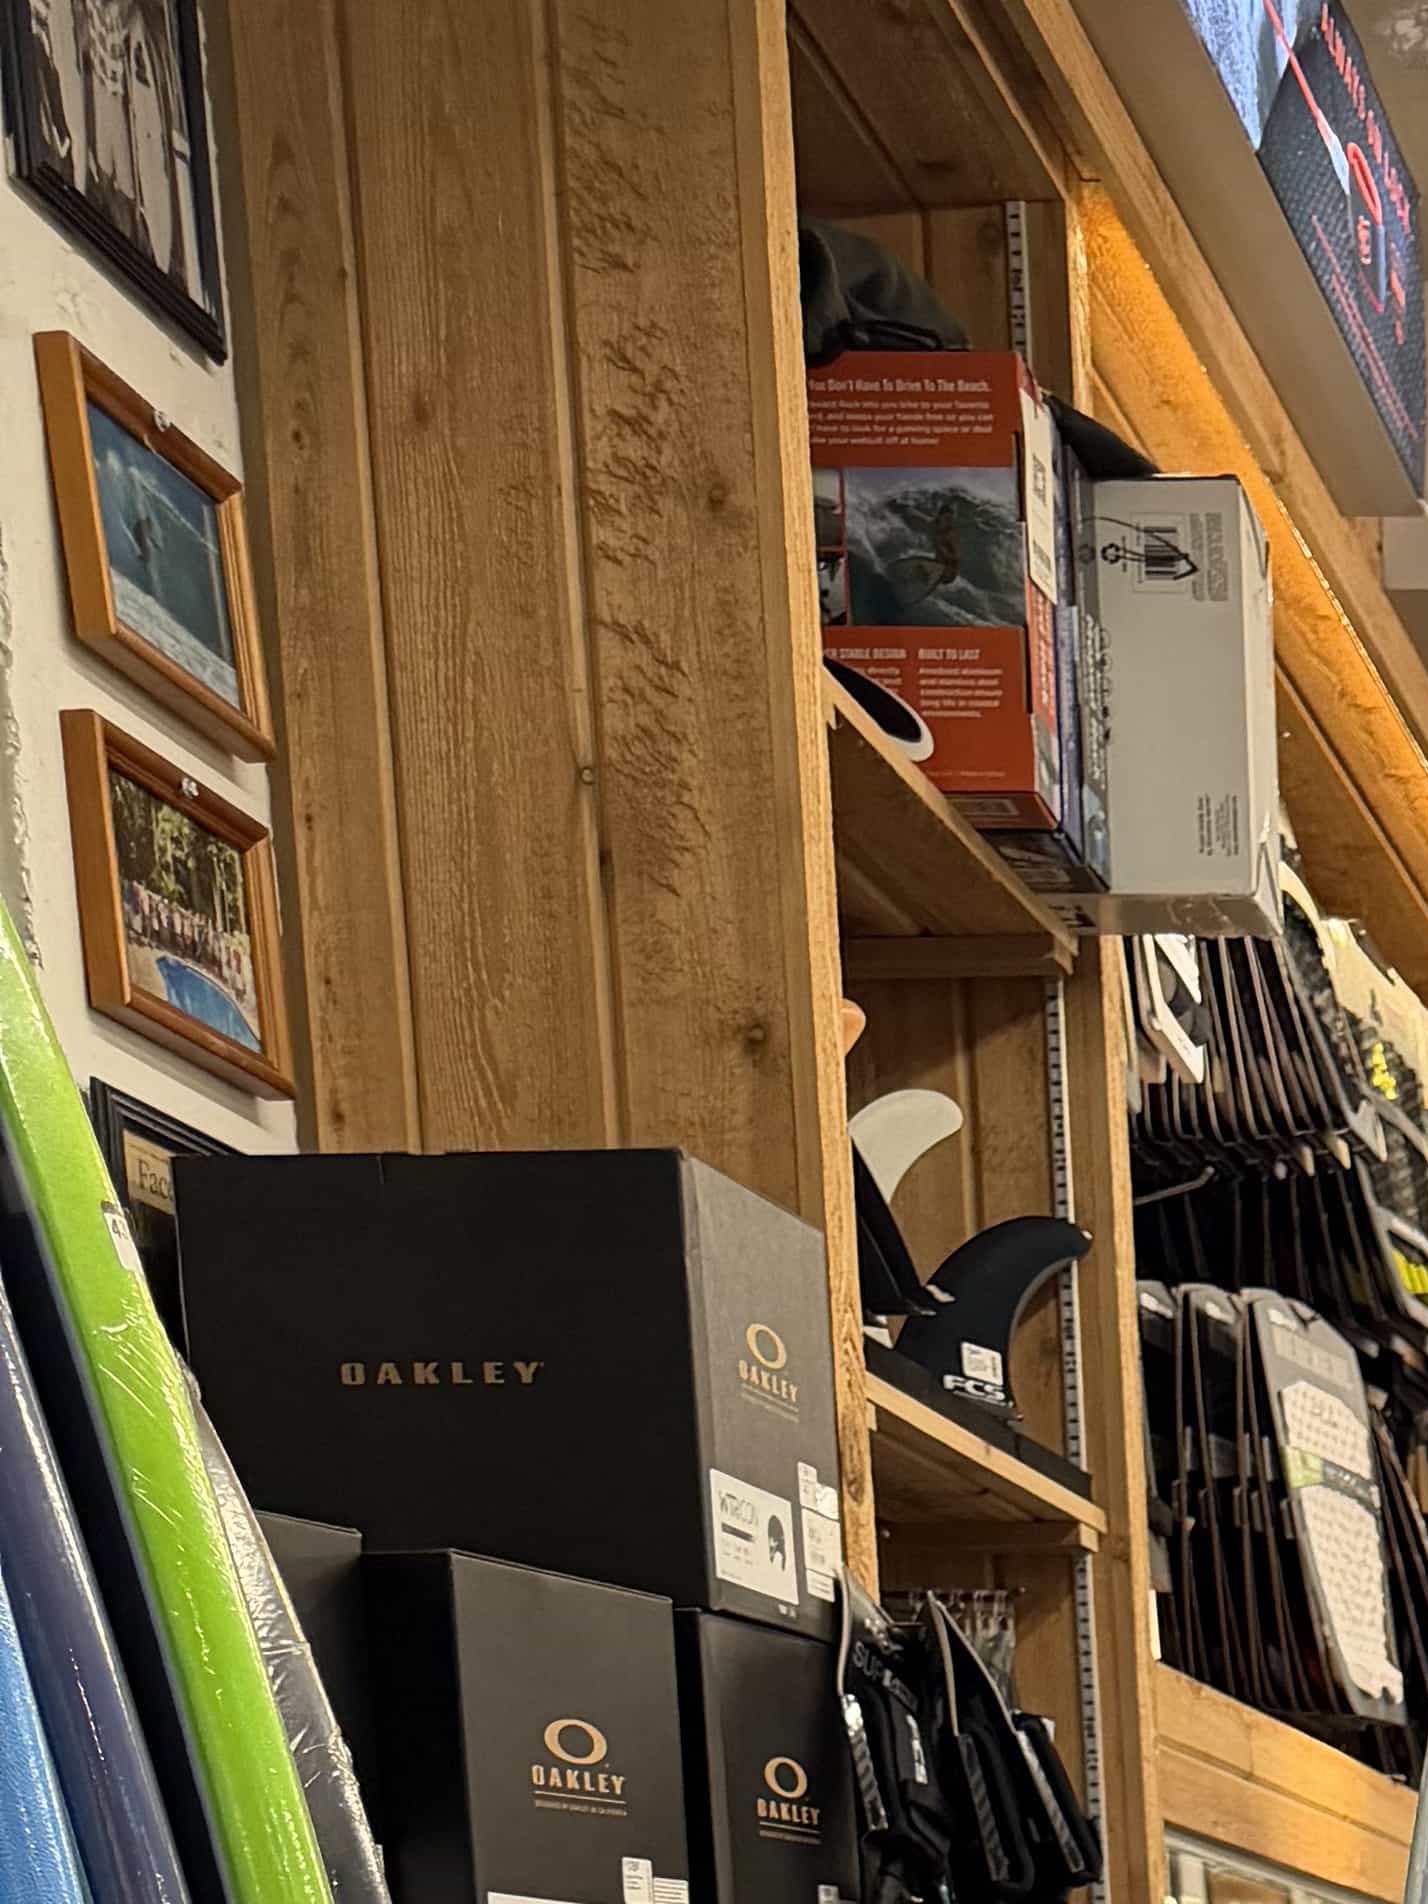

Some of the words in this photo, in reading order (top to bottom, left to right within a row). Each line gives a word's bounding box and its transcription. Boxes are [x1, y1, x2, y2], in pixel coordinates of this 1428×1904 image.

[340, 1360, 541, 1387] OAKLEY
[739, 1359, 799, 1403] OAKLEY
[531, 1764, 625, 1795] OAKLEY
[757, 1798, 820, 1826] OAKLEY
